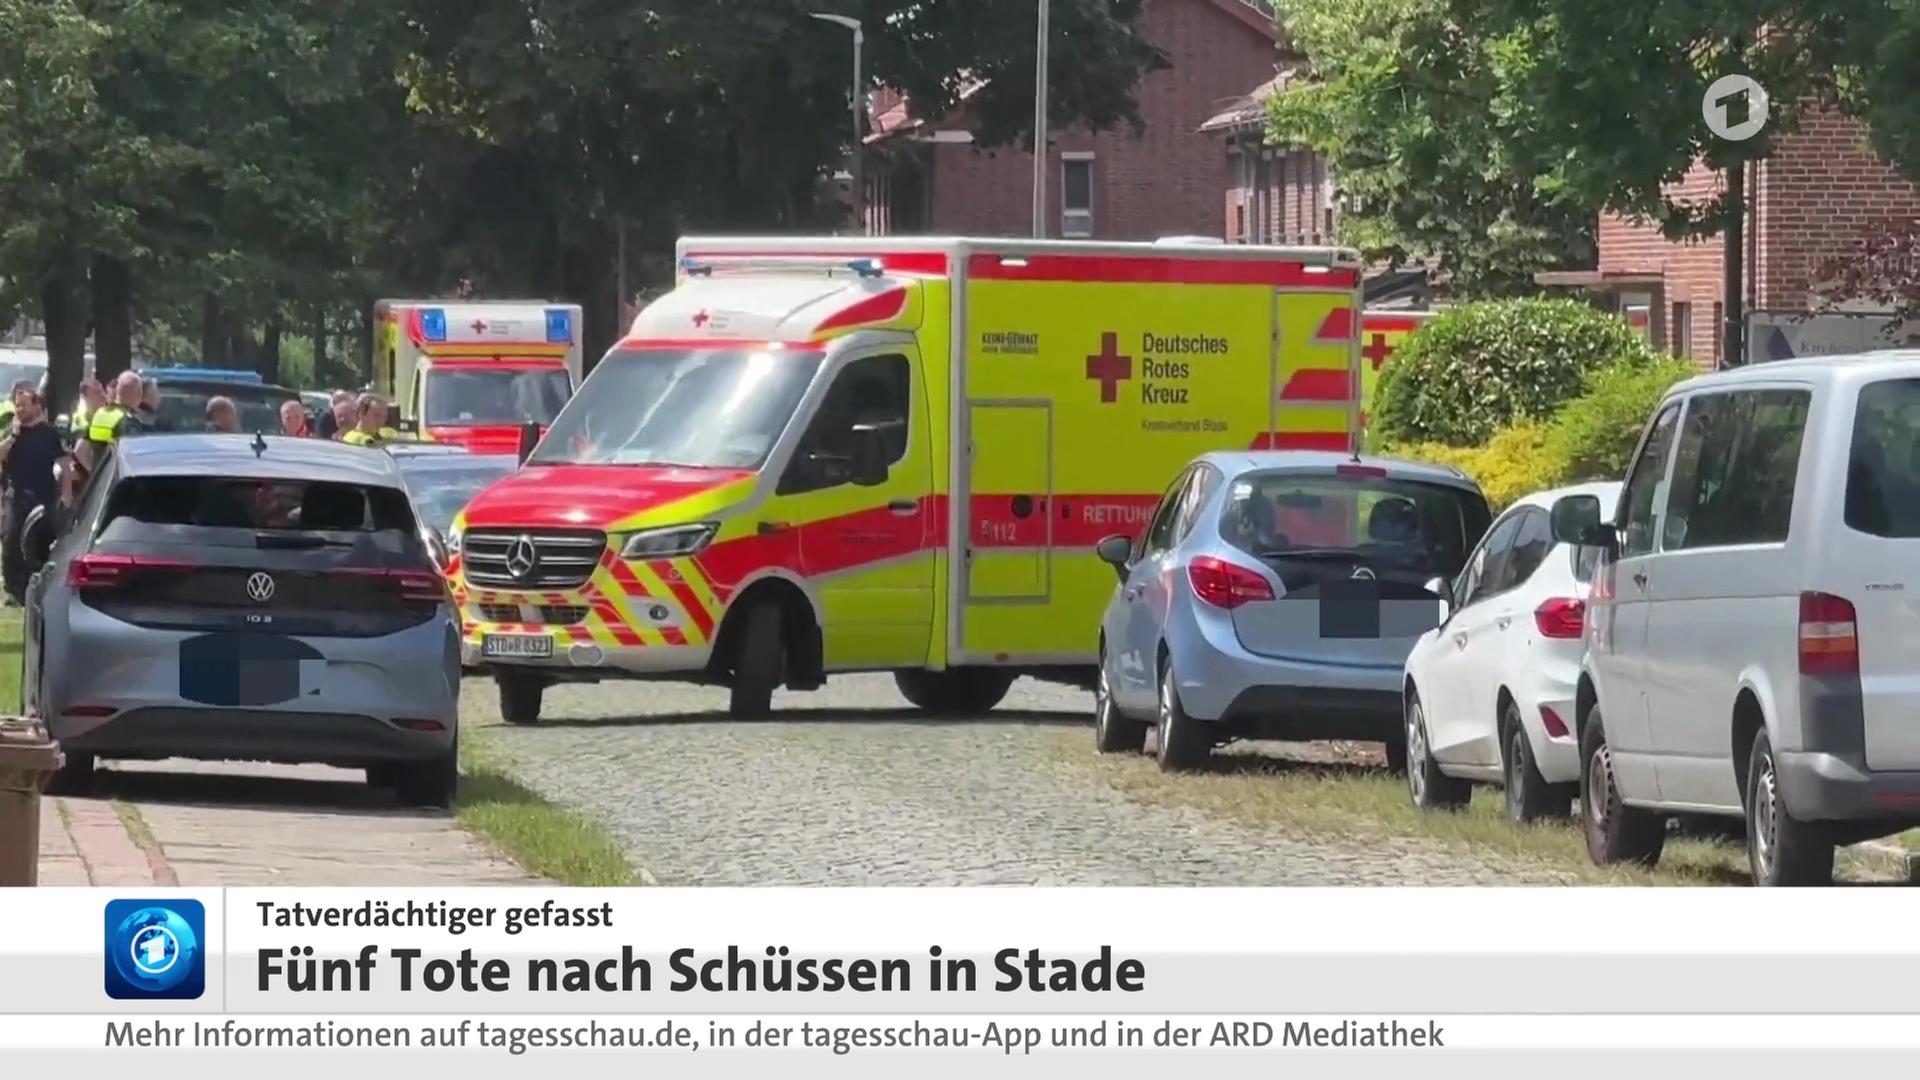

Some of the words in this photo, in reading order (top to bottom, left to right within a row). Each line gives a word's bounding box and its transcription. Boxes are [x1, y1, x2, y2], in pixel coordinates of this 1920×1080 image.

[1143, 332, 1228, 354] Deutsches
[1142, 358, 1190, 379] Rotes
[1142, 383, 1189, 404] Kreuz
